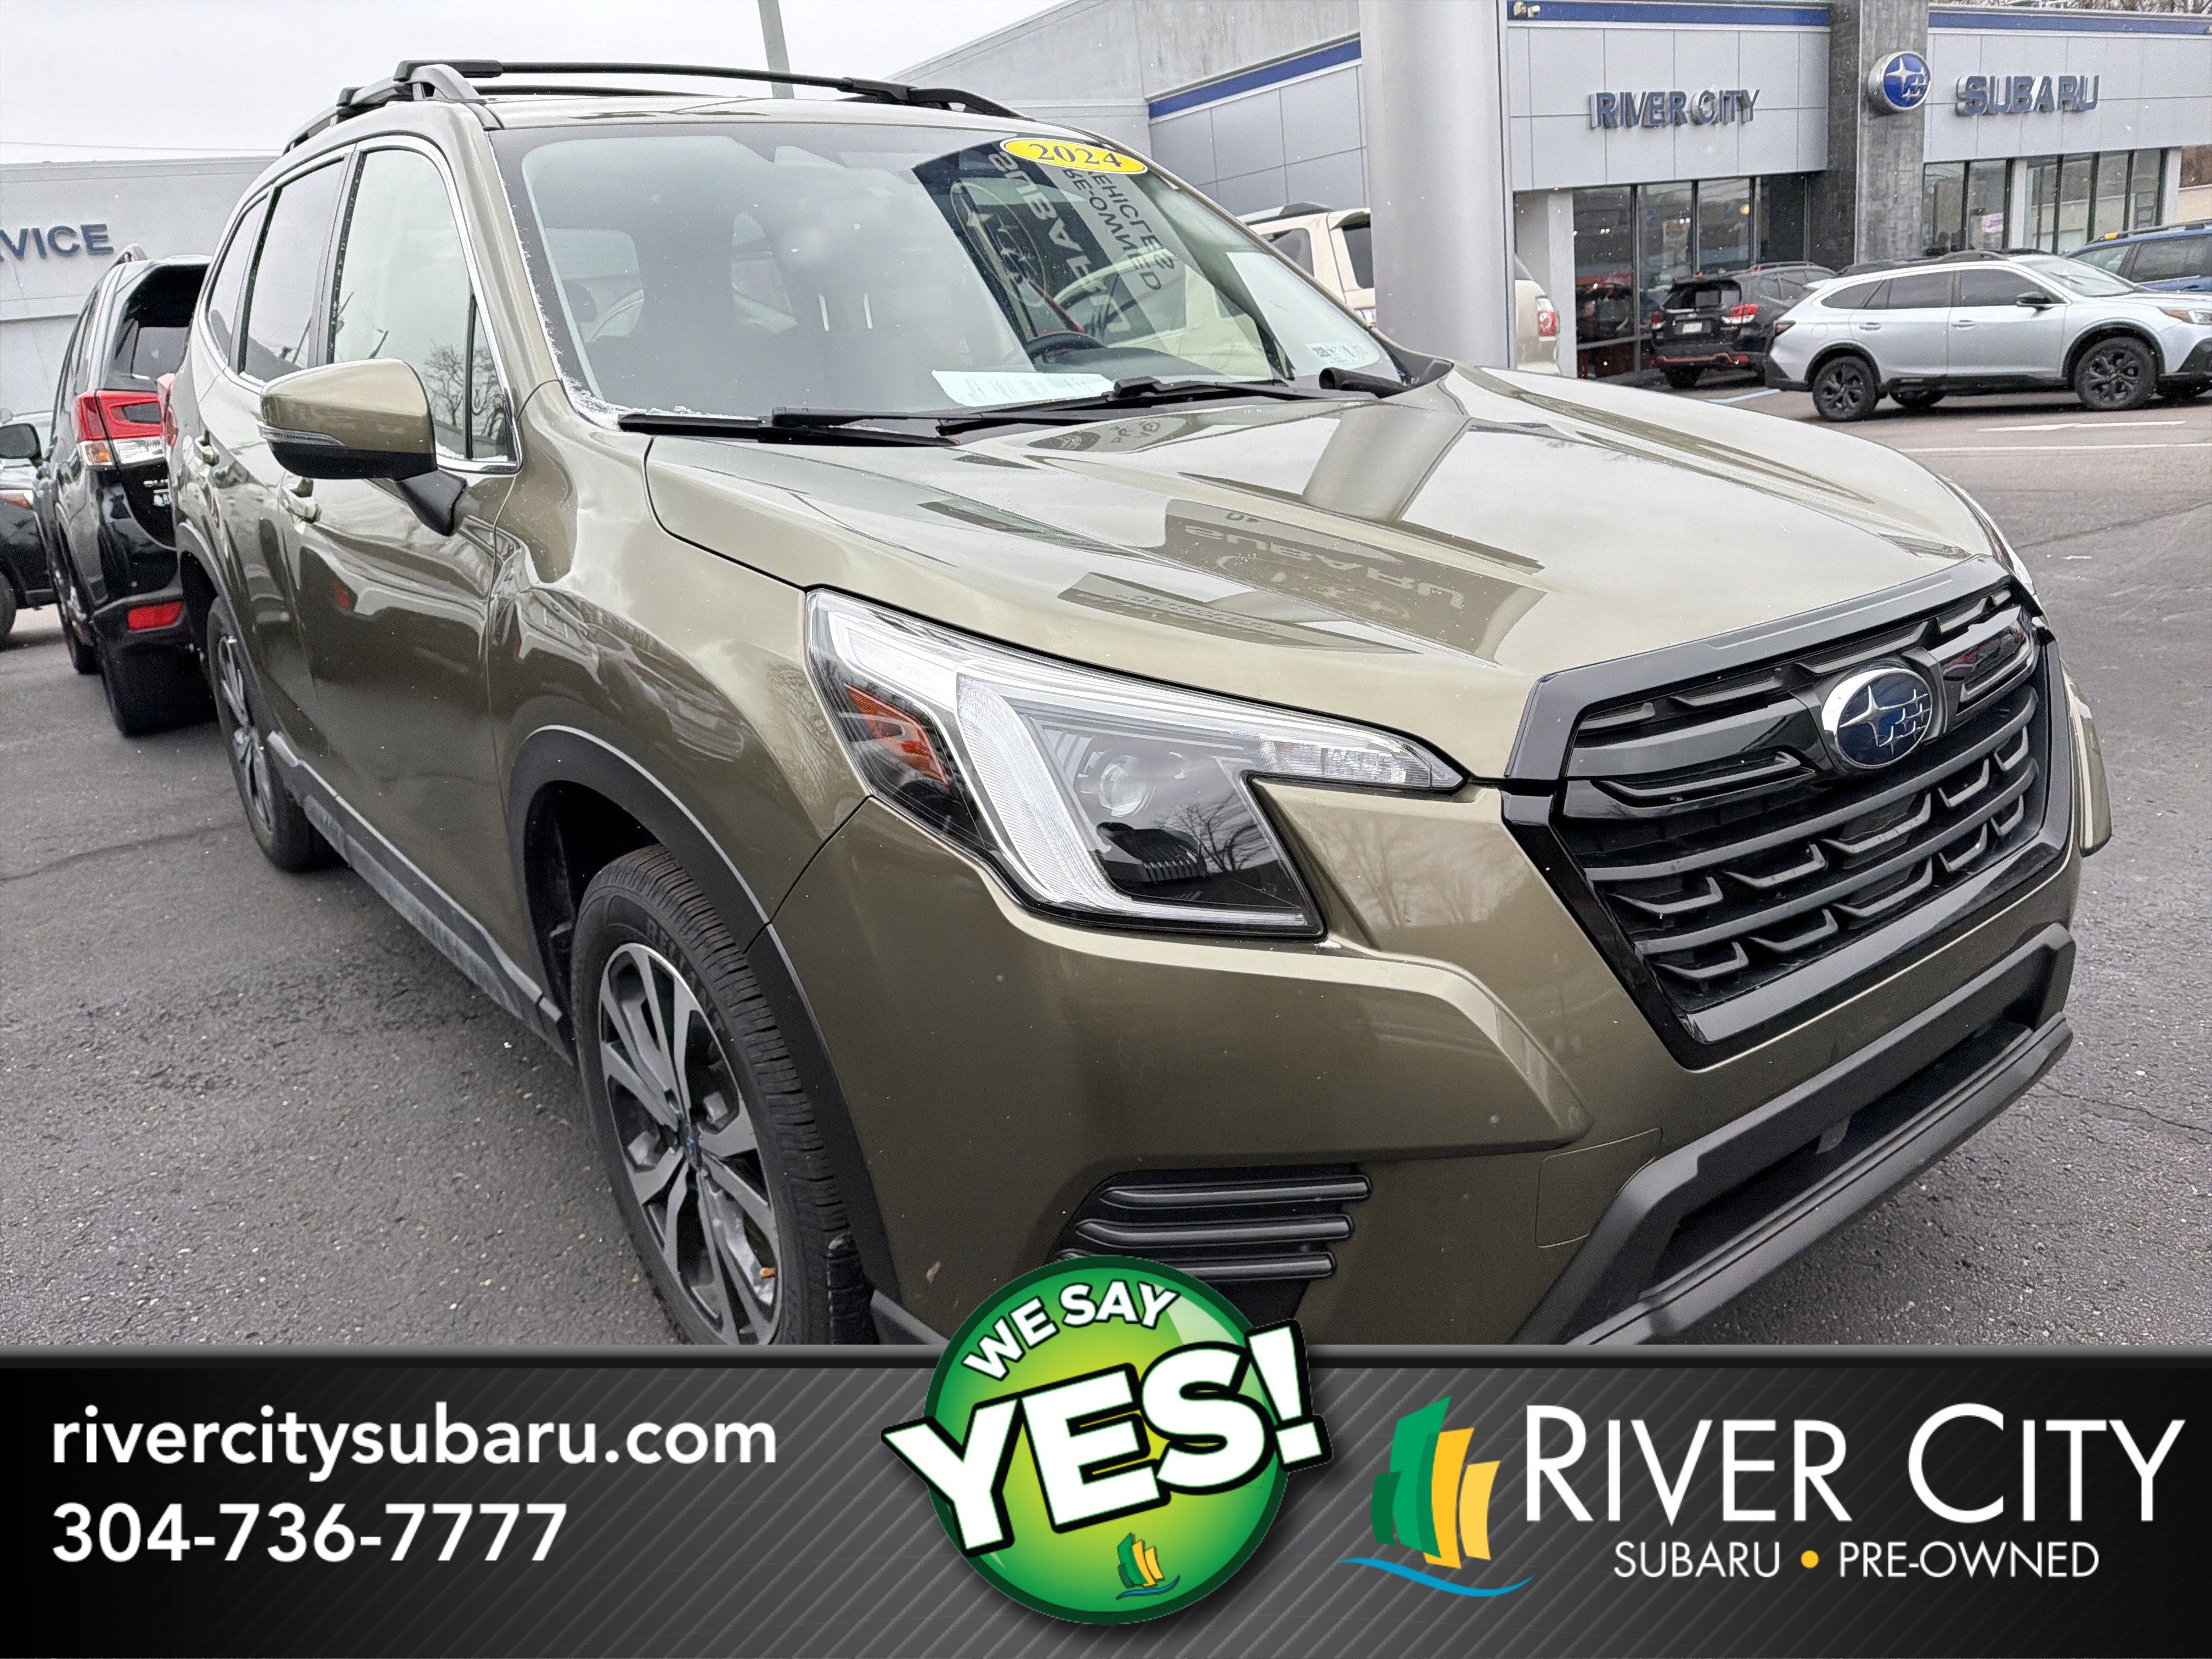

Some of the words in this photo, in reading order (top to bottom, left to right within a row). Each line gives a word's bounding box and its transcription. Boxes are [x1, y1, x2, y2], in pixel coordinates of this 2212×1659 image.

[1590, 90, 1688, 128] RIVER
[1691, 88, 1760, 126] CITY
[1956, 75, 2100, 115] SUBARU
[1029, 143, 1122, 167] 2024
[0, 223, 114, 262] VICE
